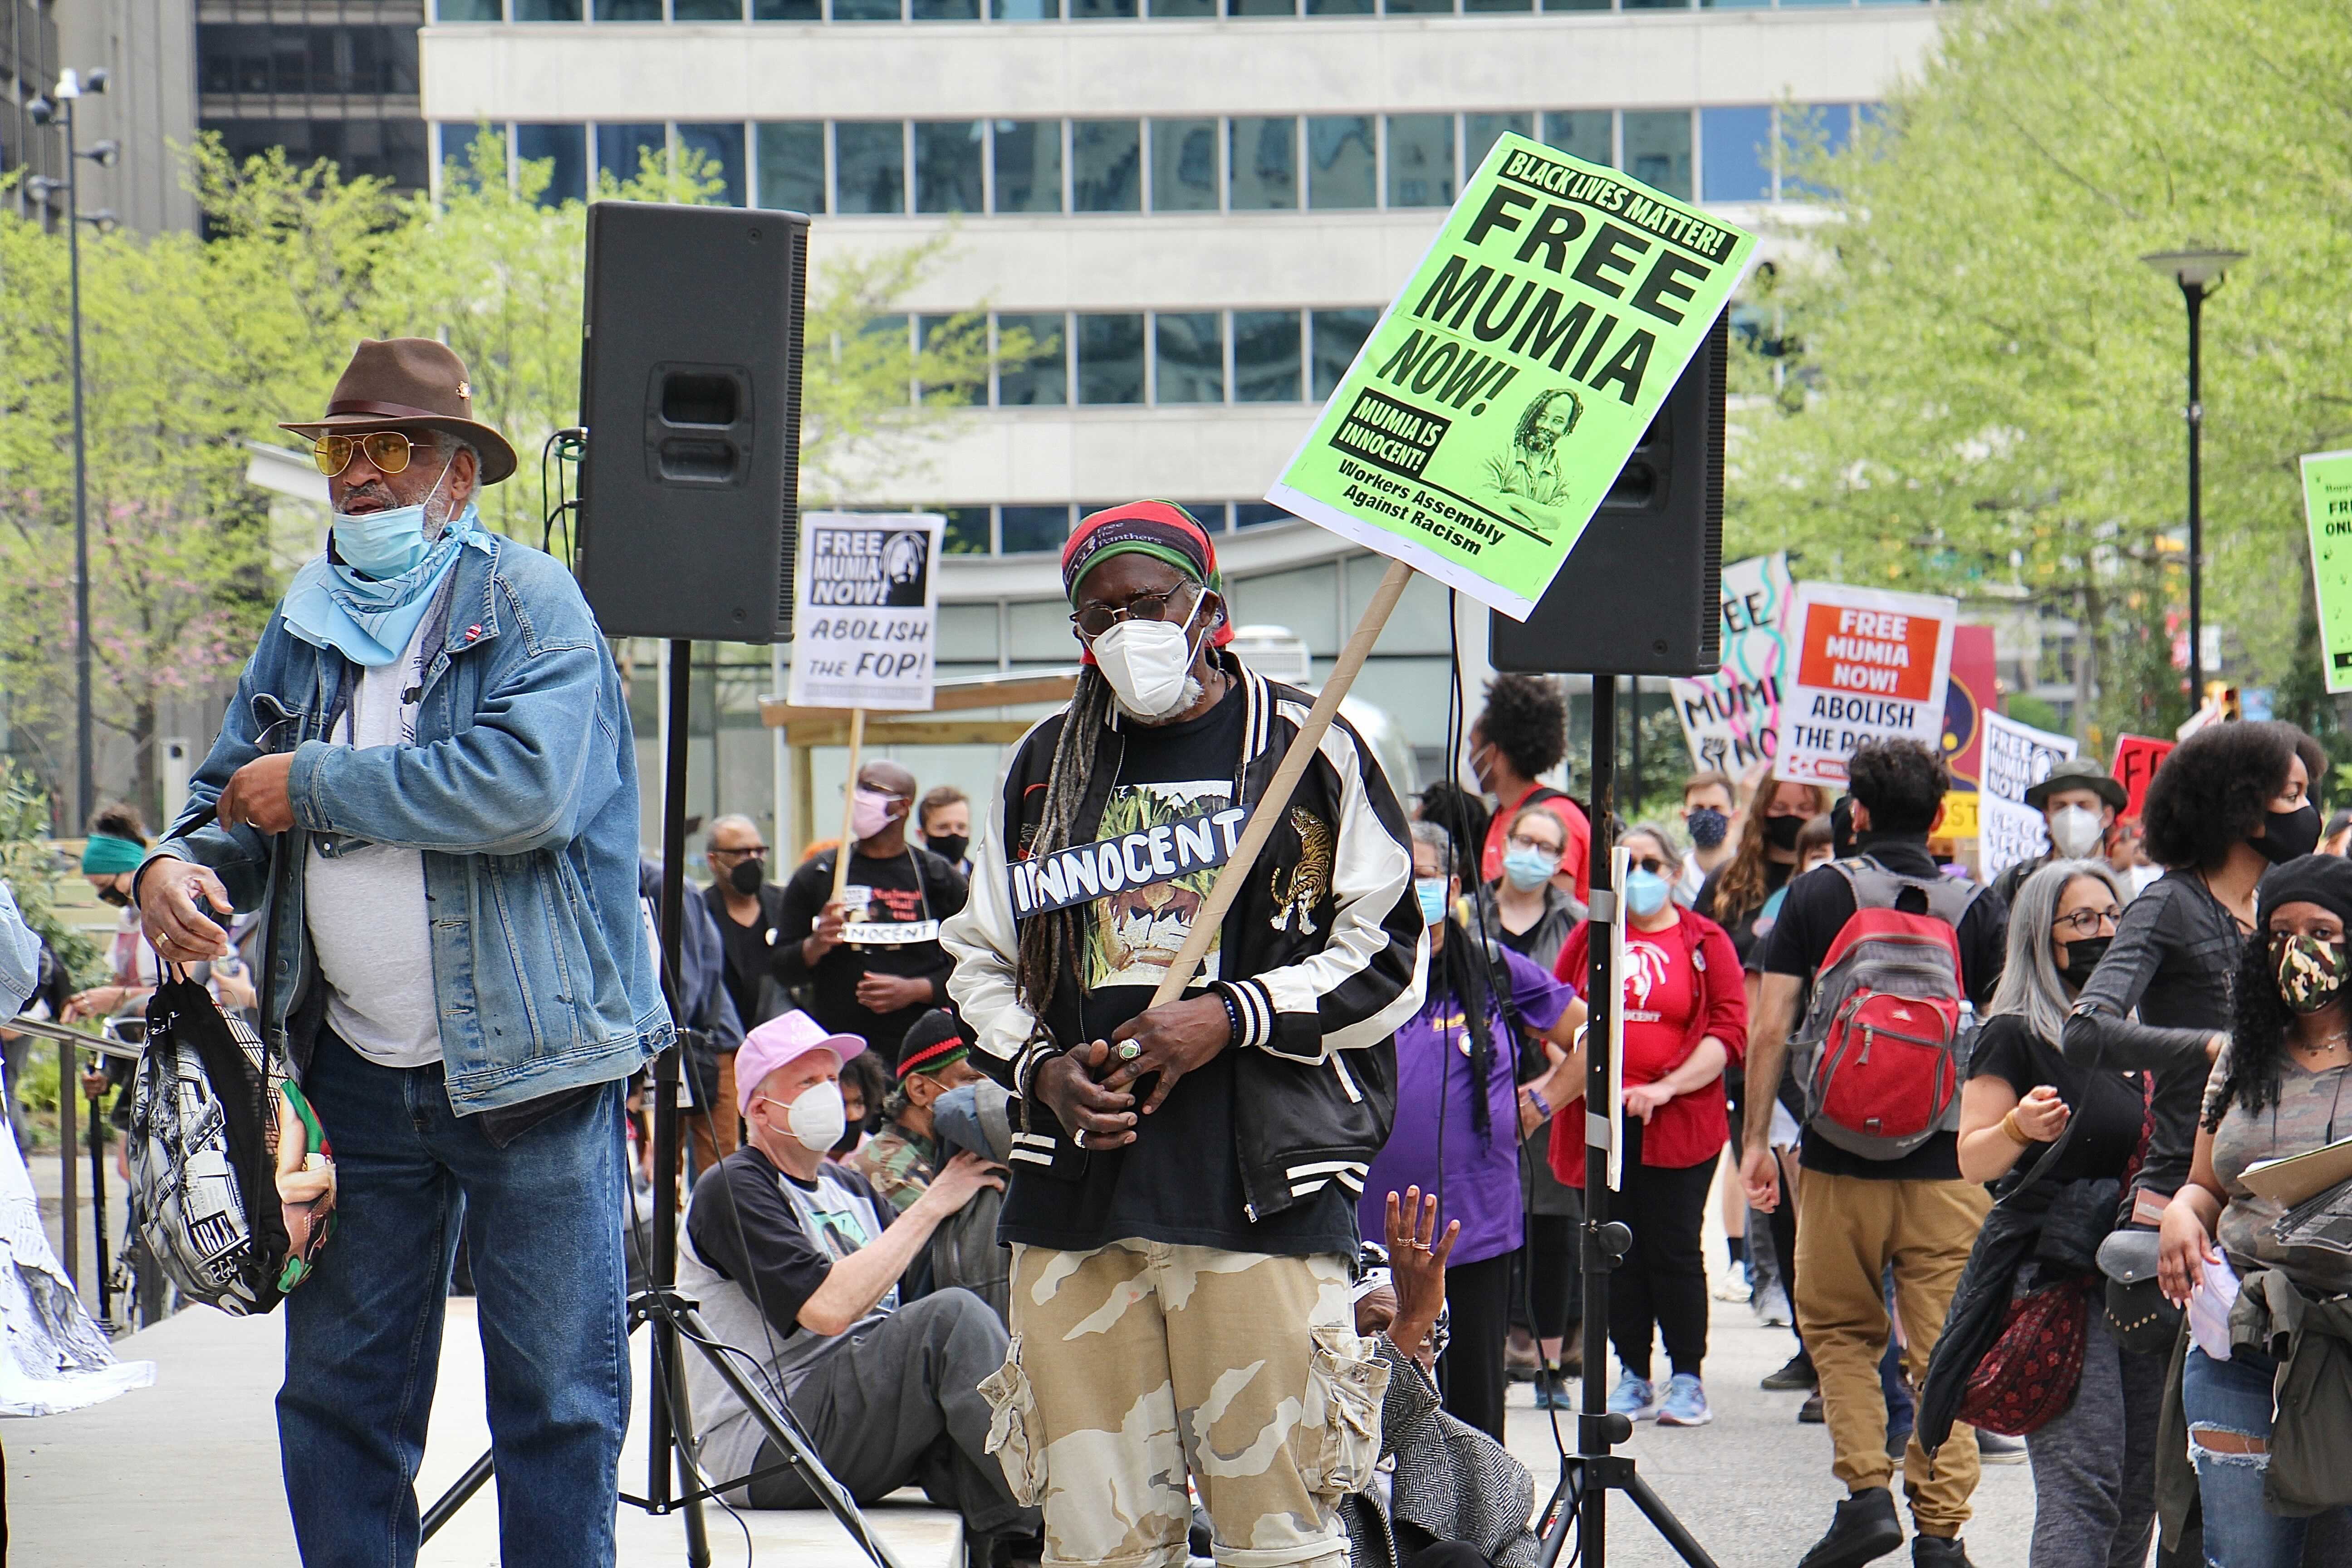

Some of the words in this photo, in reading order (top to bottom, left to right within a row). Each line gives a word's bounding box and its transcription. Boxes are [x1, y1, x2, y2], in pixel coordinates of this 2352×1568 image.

[1506, 152, 1577, 197] BLACK
[1568, 175, 1629, 211] LIVES
[1623, 195, 1727, 256] MATTER!
[1463, 184, 1711, 326] FREE
[1413, 254, 1656, 407] MUMIA
[1376, 328, 1520, 418] NOW!
[1352, 396, 1422, 441] MUMIA
[1417, 421, 1443, 447] IS
[1338, 421, 1426, 471] INNOCENT!
[1338, 459, 1411, 499] Workers
[1411, 490, 1506, 546] Assembly
[1097, 522, 1124, 534] Free
[1343, 484, 1409, 520] Against
[1410, 510, 1483, 555] Racism
[817, 530, 885, 556] FREE
[1099, 533, 1162, 547] Panthers
[814, 556, 882, 581] MUMIA
[812, 580, 890, 605] NOW!
[810, 619, 928, 642] ABOLISH
[1839, 608, 1909, 642] FREE
[809, 658, 848, 677] THE
[855, 652, 926, 679] FOP!
[1825, 635, 1909, 668] MUMIA
[1833, 662, 1899, 693] NOW!
[1812, 695, 1914, 728] ABOLISH
[1795, 725, 1834, 749] THE
[1991, 726, 2033, 762] FREE
[1013, 808, 1245, 912] INNOCENT
